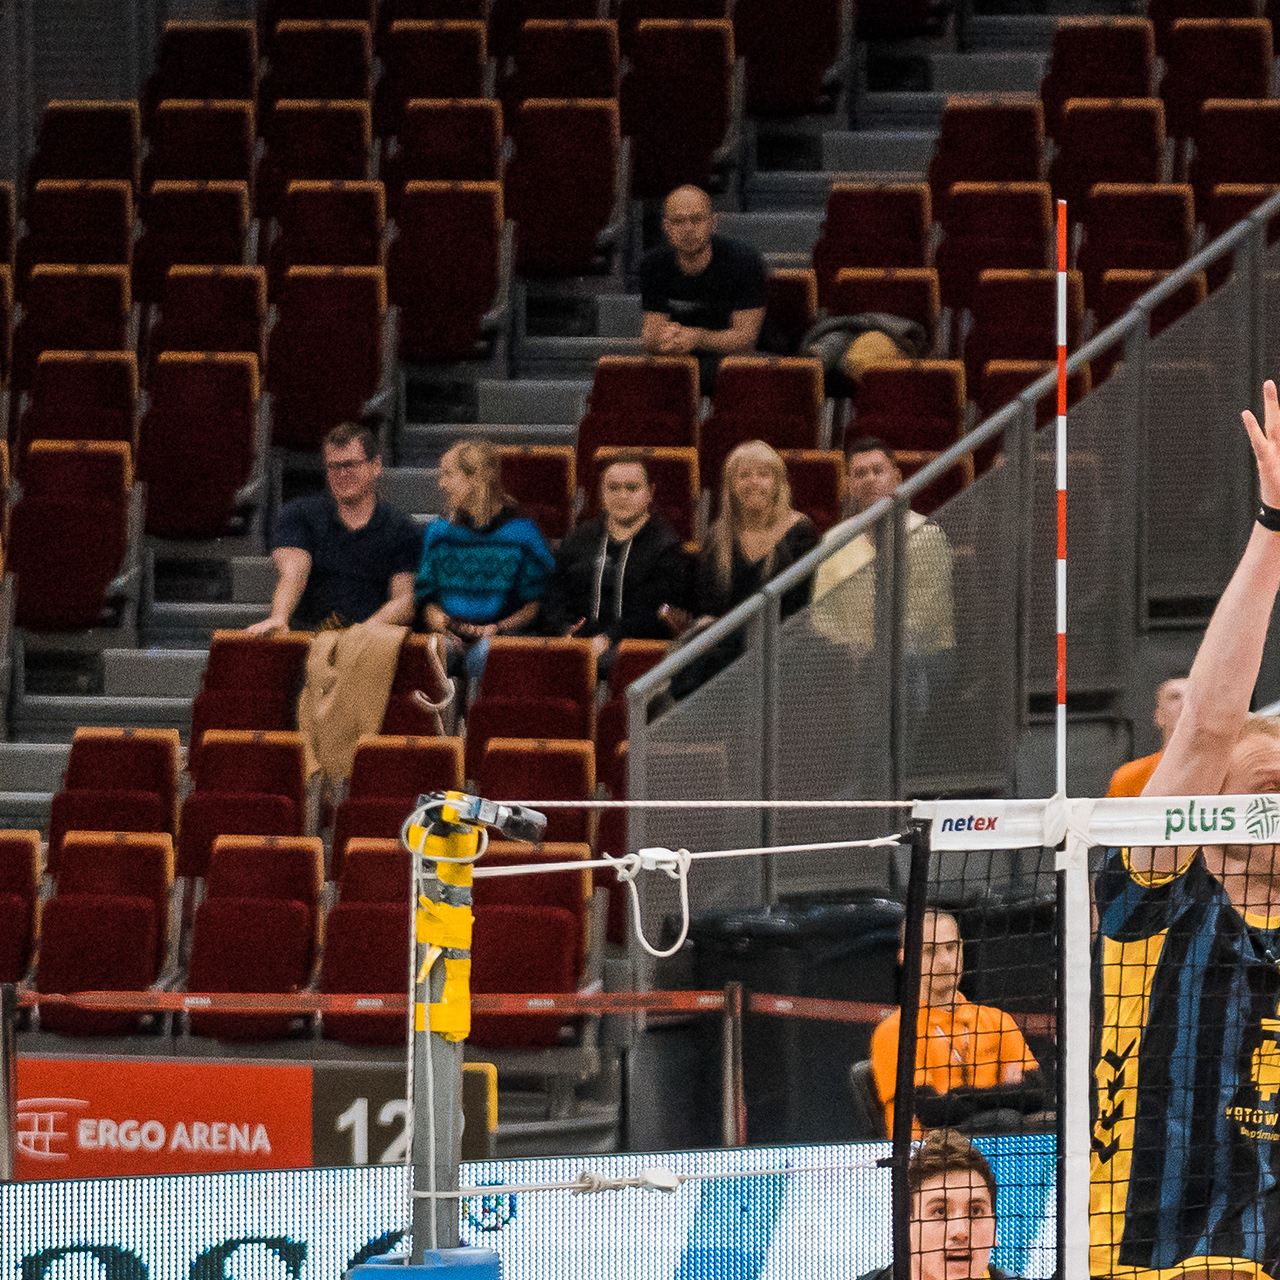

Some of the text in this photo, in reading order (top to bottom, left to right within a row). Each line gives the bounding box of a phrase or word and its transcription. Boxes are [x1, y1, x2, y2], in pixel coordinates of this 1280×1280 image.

[941, 817, 998, 832] netex
[1165, 799, 1236, 840] plus
[77, 1117, 272, 1154] ERGO ARENA
